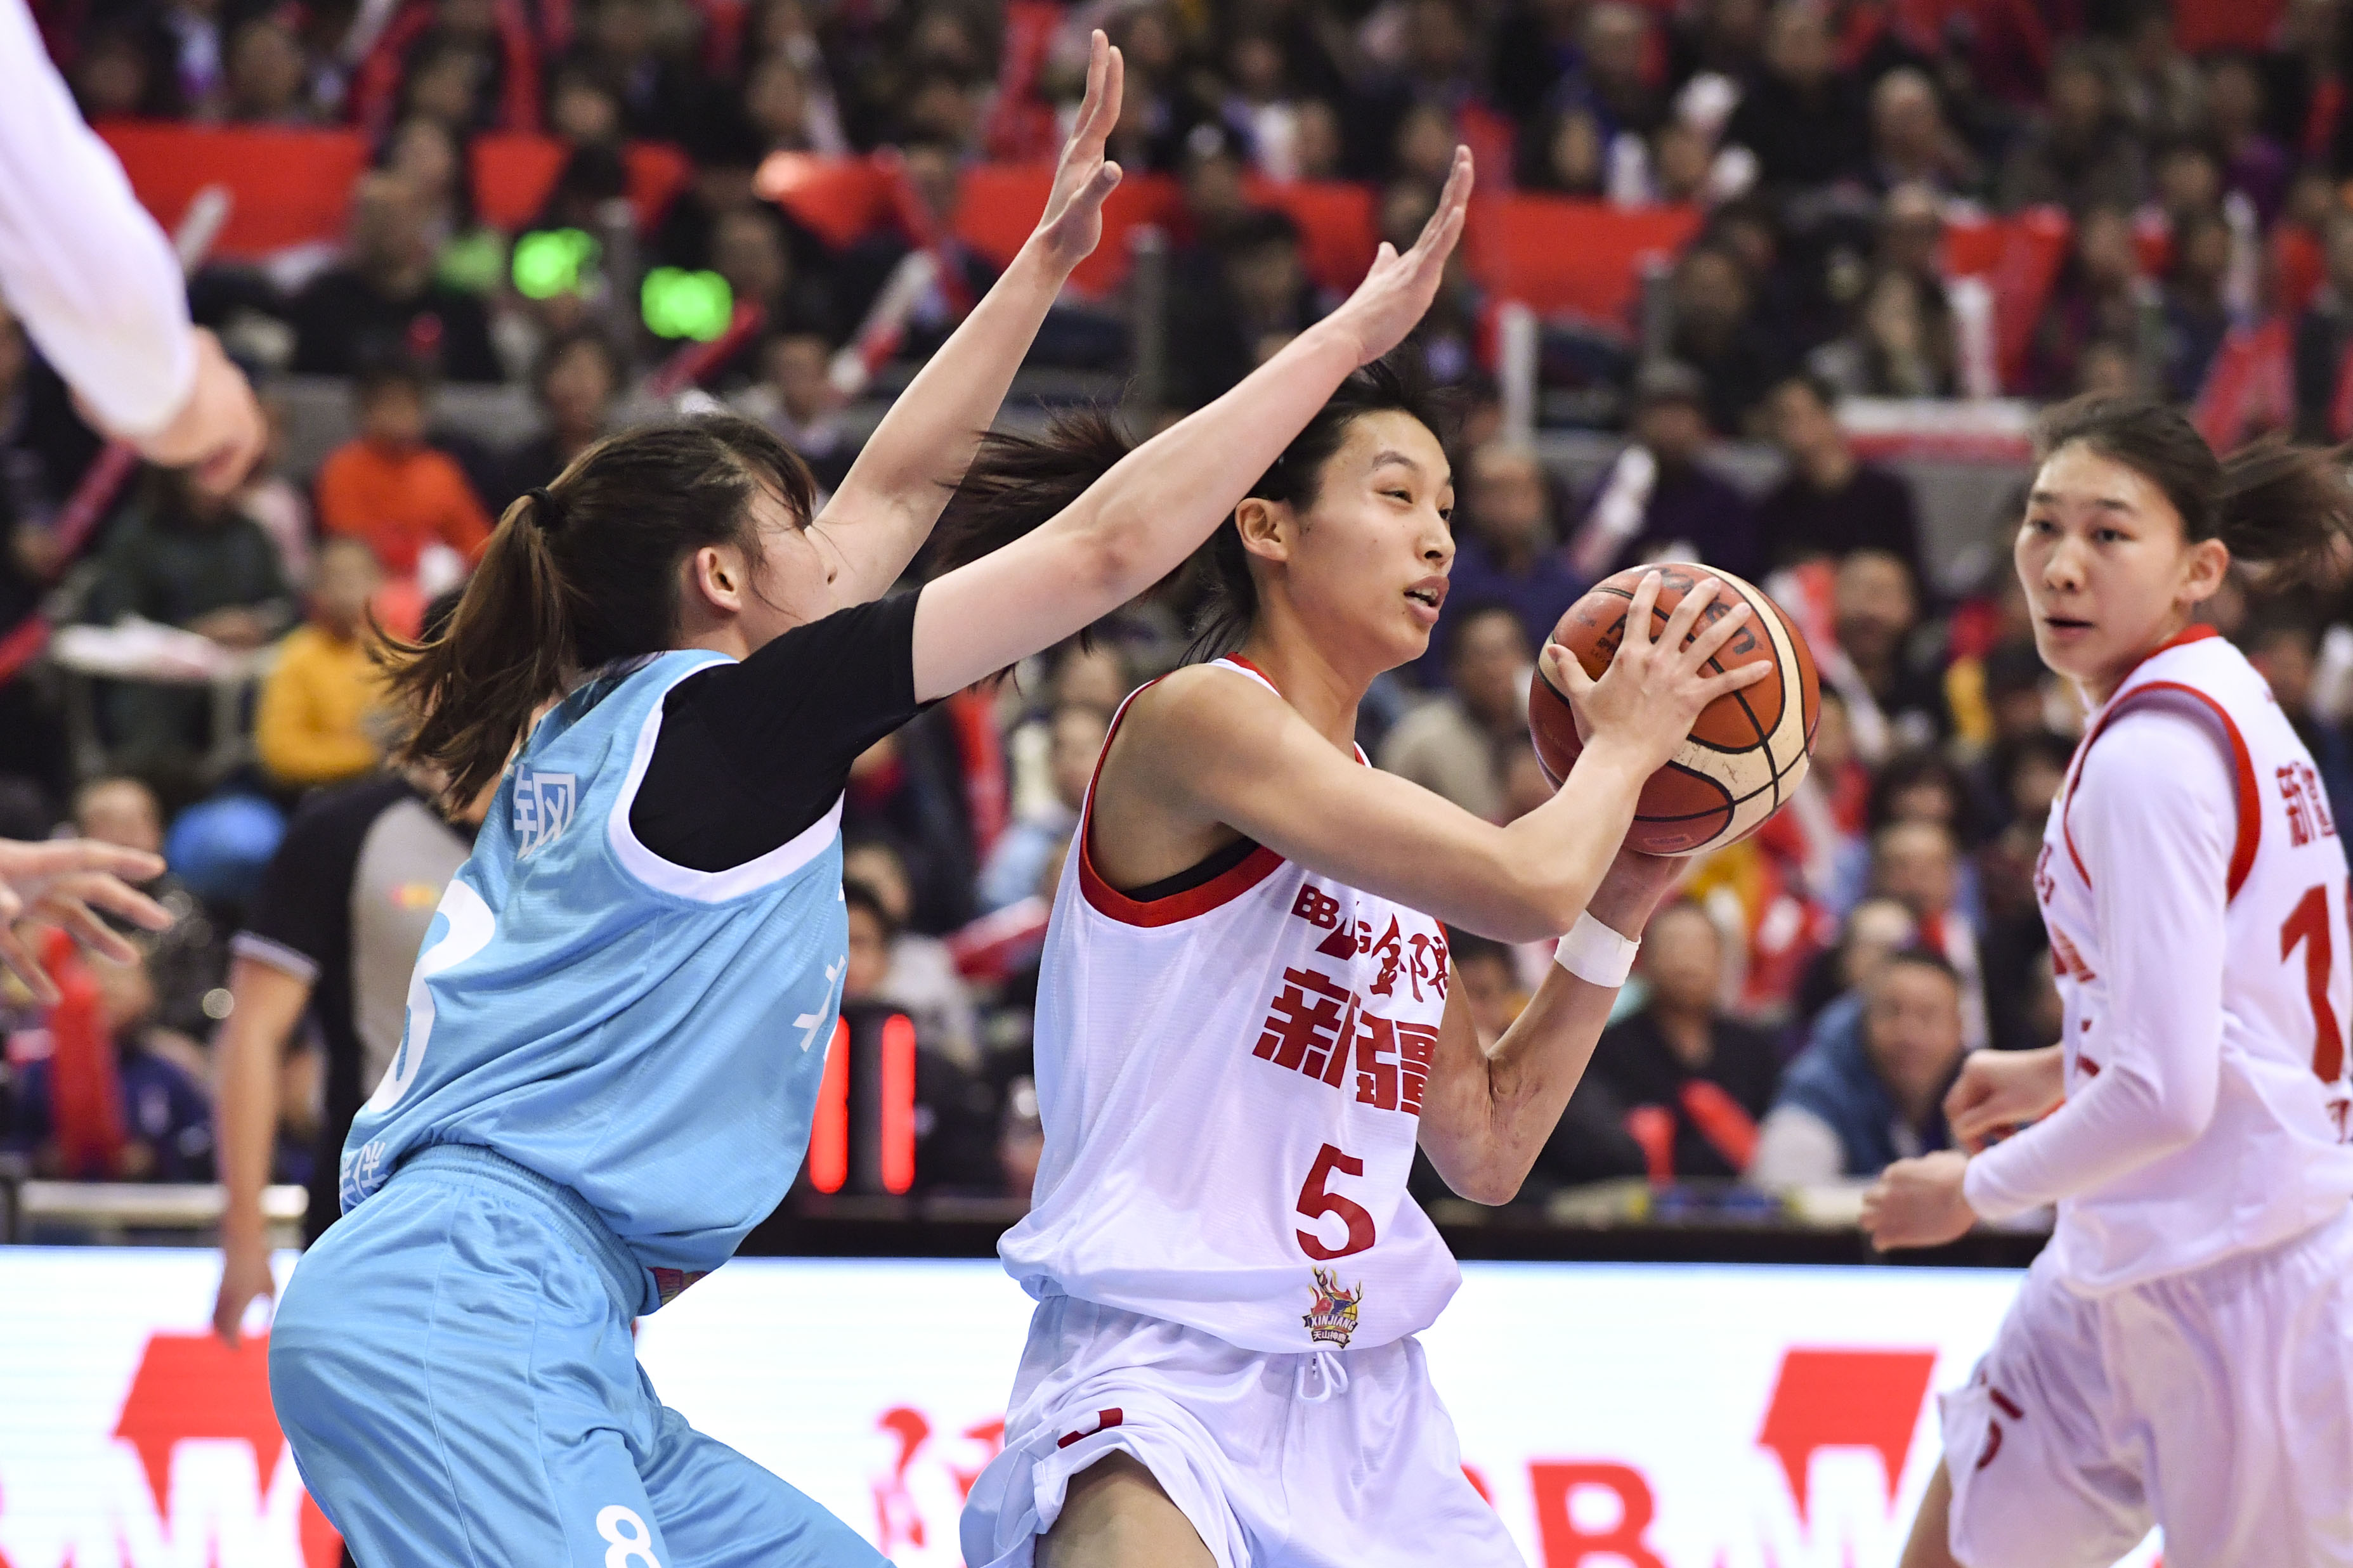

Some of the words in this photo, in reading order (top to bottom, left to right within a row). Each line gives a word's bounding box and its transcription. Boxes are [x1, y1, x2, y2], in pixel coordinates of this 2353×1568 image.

[1252, 968, 1438, 1116] 新疆
[1296, 1142, 1376, 1261] 5
[1310, 1314, 1356, 1332] XINJIANG
[1312, 1330, 1347, 1343] 天山神鹿
[596, 1504, 662, 1568] 8
